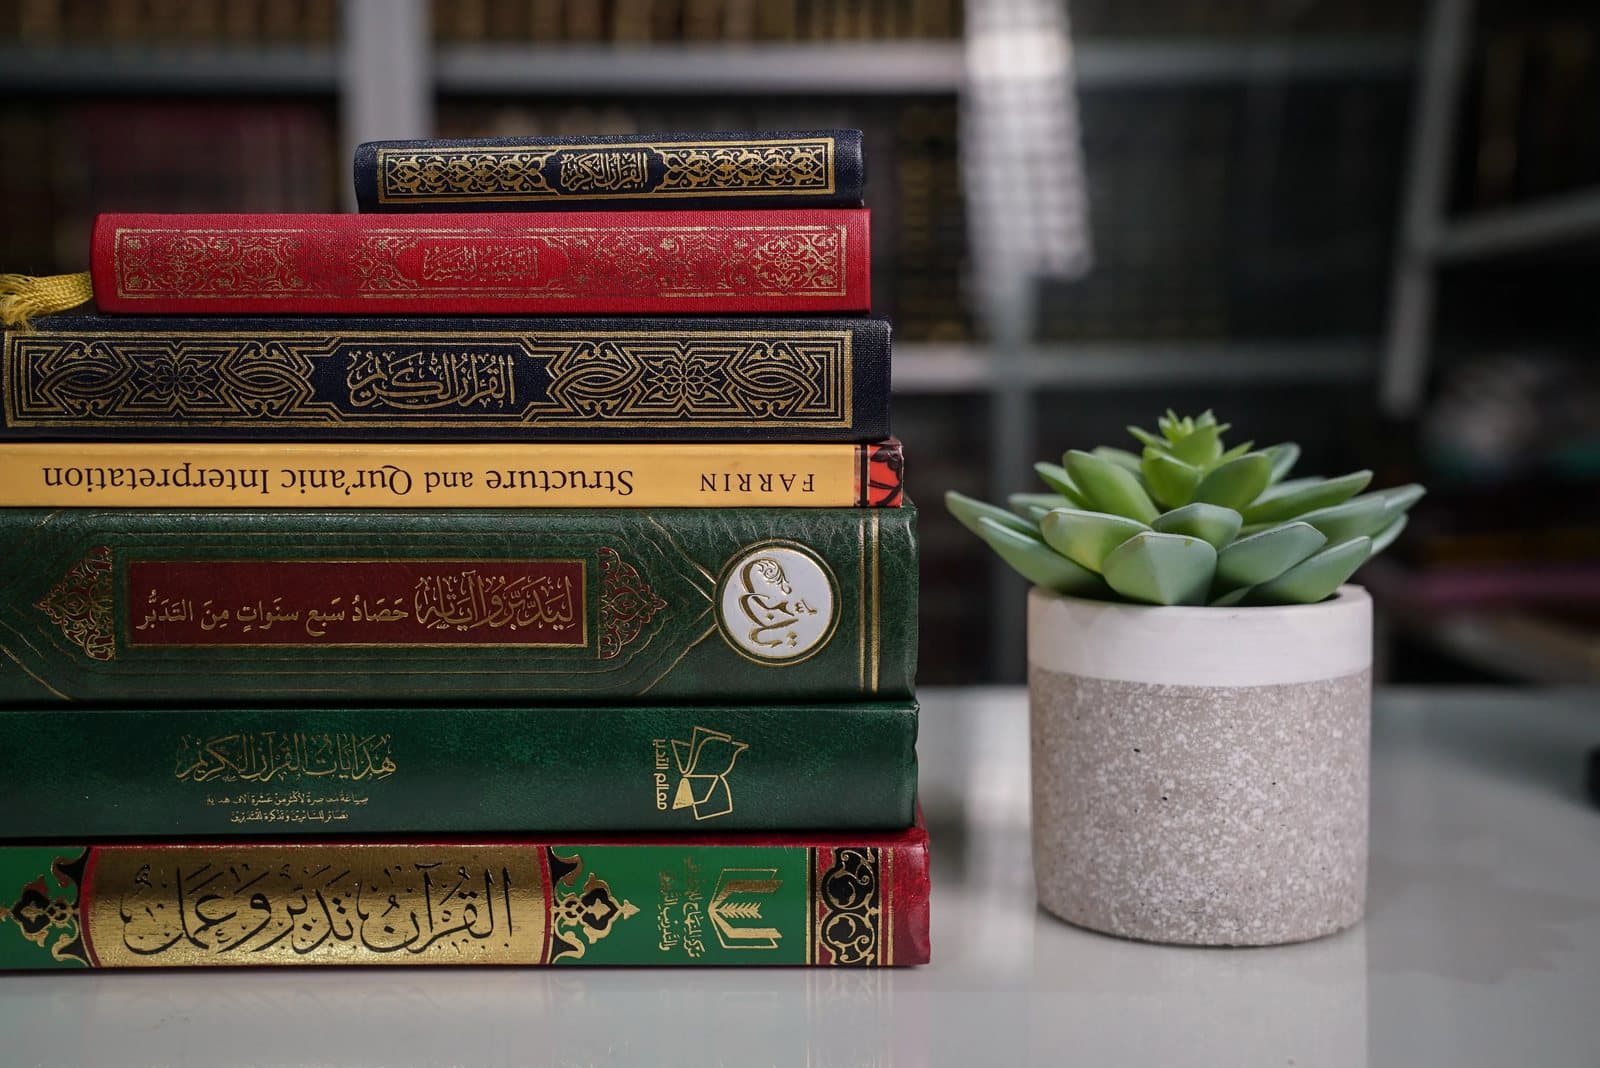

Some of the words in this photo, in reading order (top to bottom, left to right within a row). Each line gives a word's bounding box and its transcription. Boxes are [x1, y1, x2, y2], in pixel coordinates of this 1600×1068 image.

[42, 462, 270, 494] Interpretation
[425, 470, 473, 494] and
[486, 469, 635, 496] Structure
[699, 472, 816, 493] FARRIN
[653, 772, 670, 811] معالم
